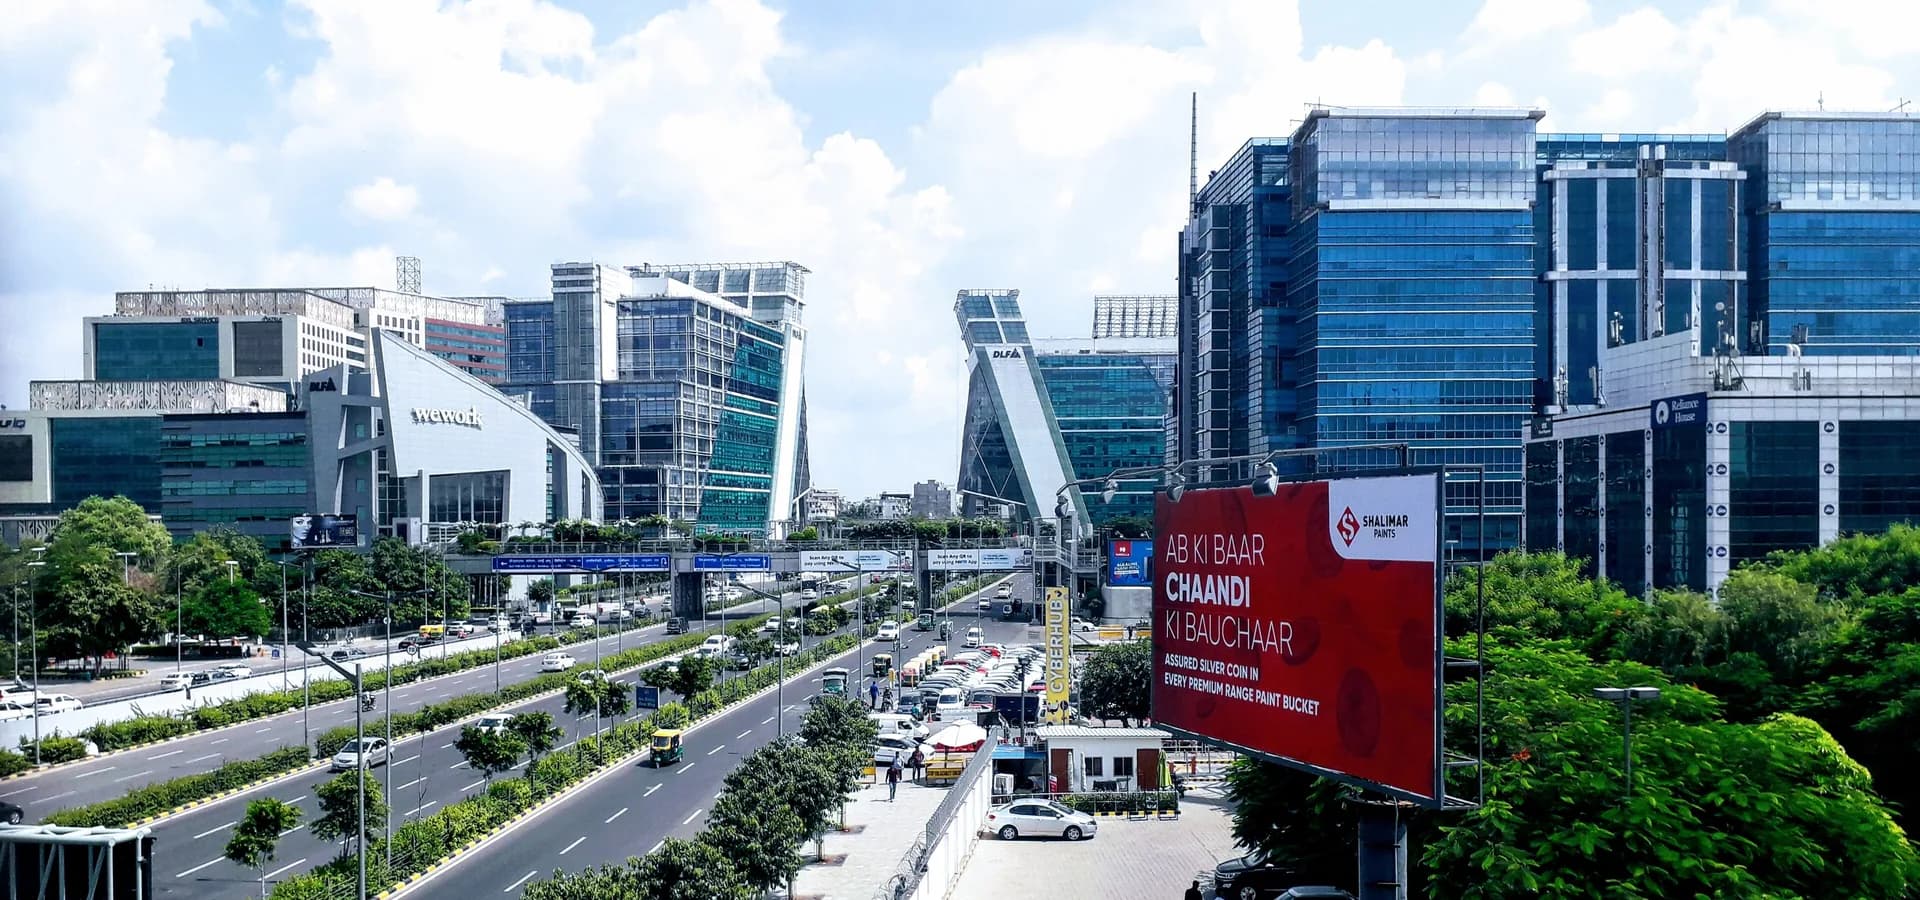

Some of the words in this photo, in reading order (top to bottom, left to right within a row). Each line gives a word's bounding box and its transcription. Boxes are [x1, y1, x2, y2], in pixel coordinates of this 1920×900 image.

[993, 350, 1012, 359] DLF
[414, 405, 482, 425] wework
[1672, 399, 1699, 411] Reliance
[1675, 412, 1696, 423] House
[1363, 515, 1408, 528] SHALIMAR
[1374, 529, 1396, 538] PAINTS
[1166, 534, 1188, 563] AB
[1194, 534, 1207, 564] KI
[1214, 534, 1265, 566] BAAR
[1166, 572, 1250, 607] CHAANDI
[1166, 610, 1180, 640] KI
[1185, 612, 1293, 656] BAUCHAAR
[1050, 600, 1066, 693] CYBERHUB
[1165, 653, 1198, 671] ASSURED
[1200, 658, 1225, 675] SILVER
[1227, 663, 1248, 679] COIN
[1250, 667, 1259, 681] IN
[1164, 672, 1187, 688] EVERY
[1188, 679, 1224, 696] PREMIUM
[1225, 686, 1254, 702] RANGE
[1256, 691, 1281, 708] PAINT
[1283, 695, 1320, 716] BUCKET
